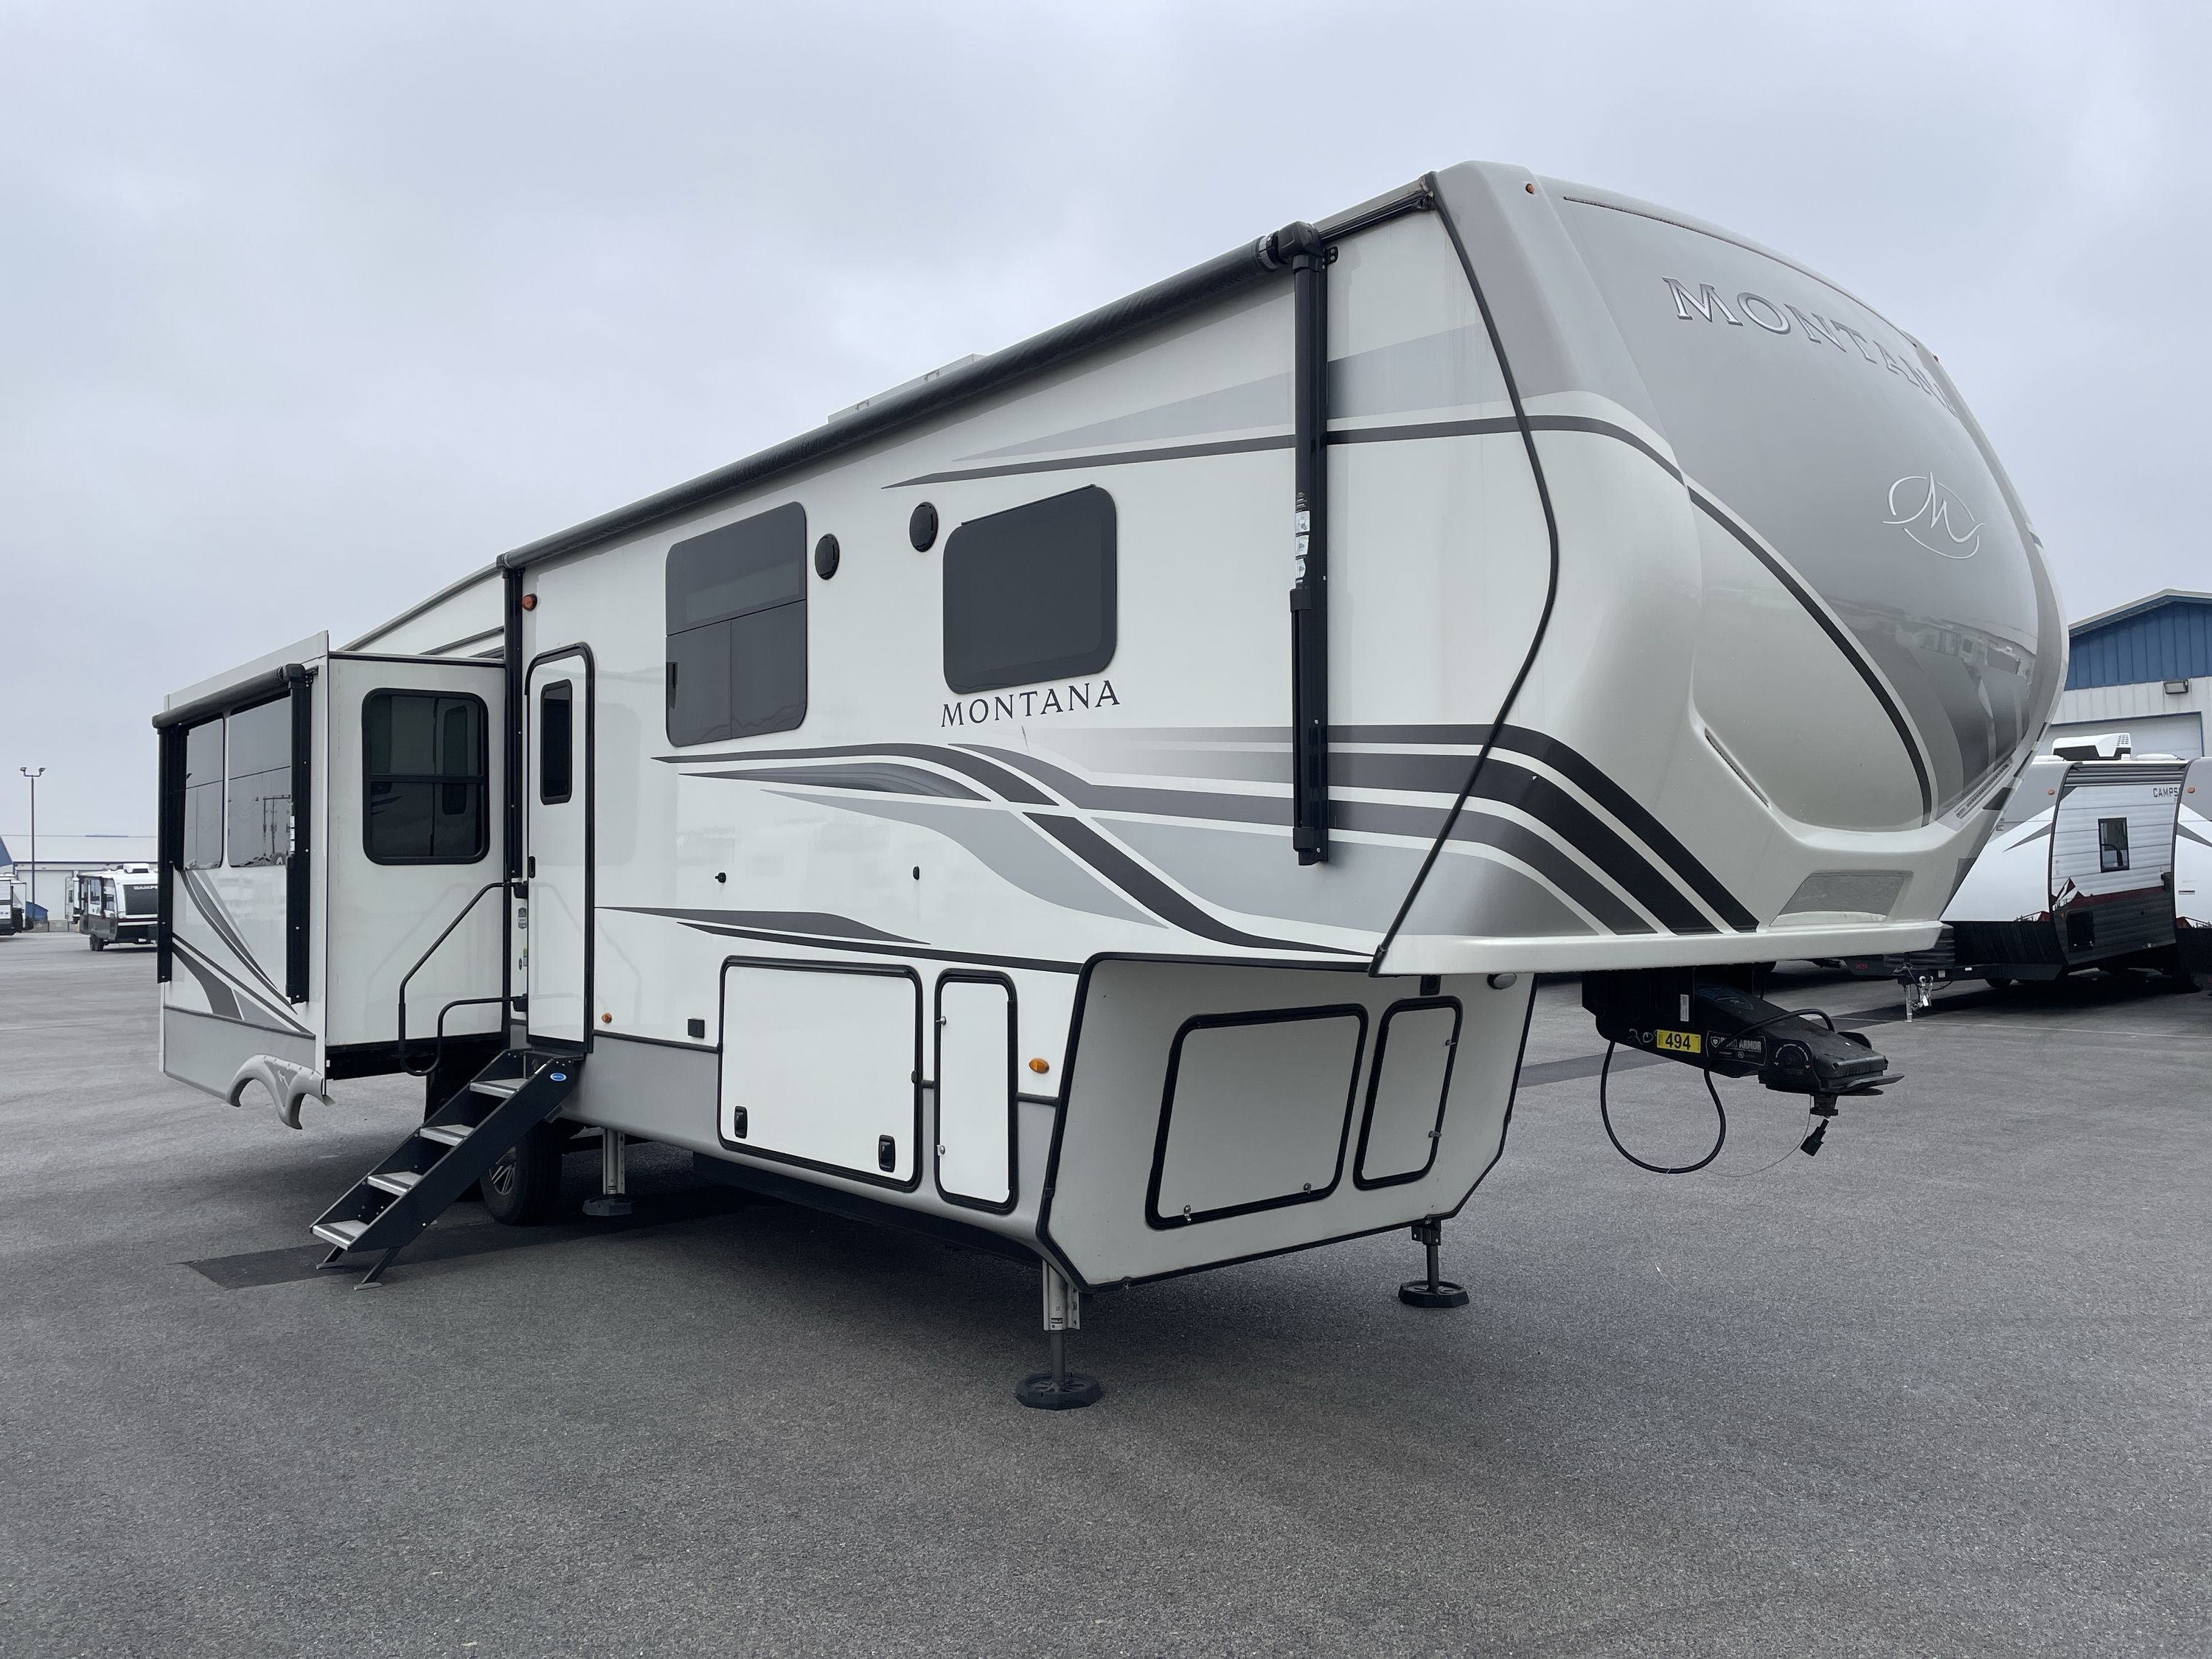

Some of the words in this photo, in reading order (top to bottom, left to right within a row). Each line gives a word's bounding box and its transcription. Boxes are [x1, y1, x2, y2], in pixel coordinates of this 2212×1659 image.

[941, 680, 1120, 728] MONTANA
[2153, 787, 2180, 798] CAMPS
[1665, 1033, 1691, 1050] 494
[1739, 1039, 1762, 1051] ARMOR
